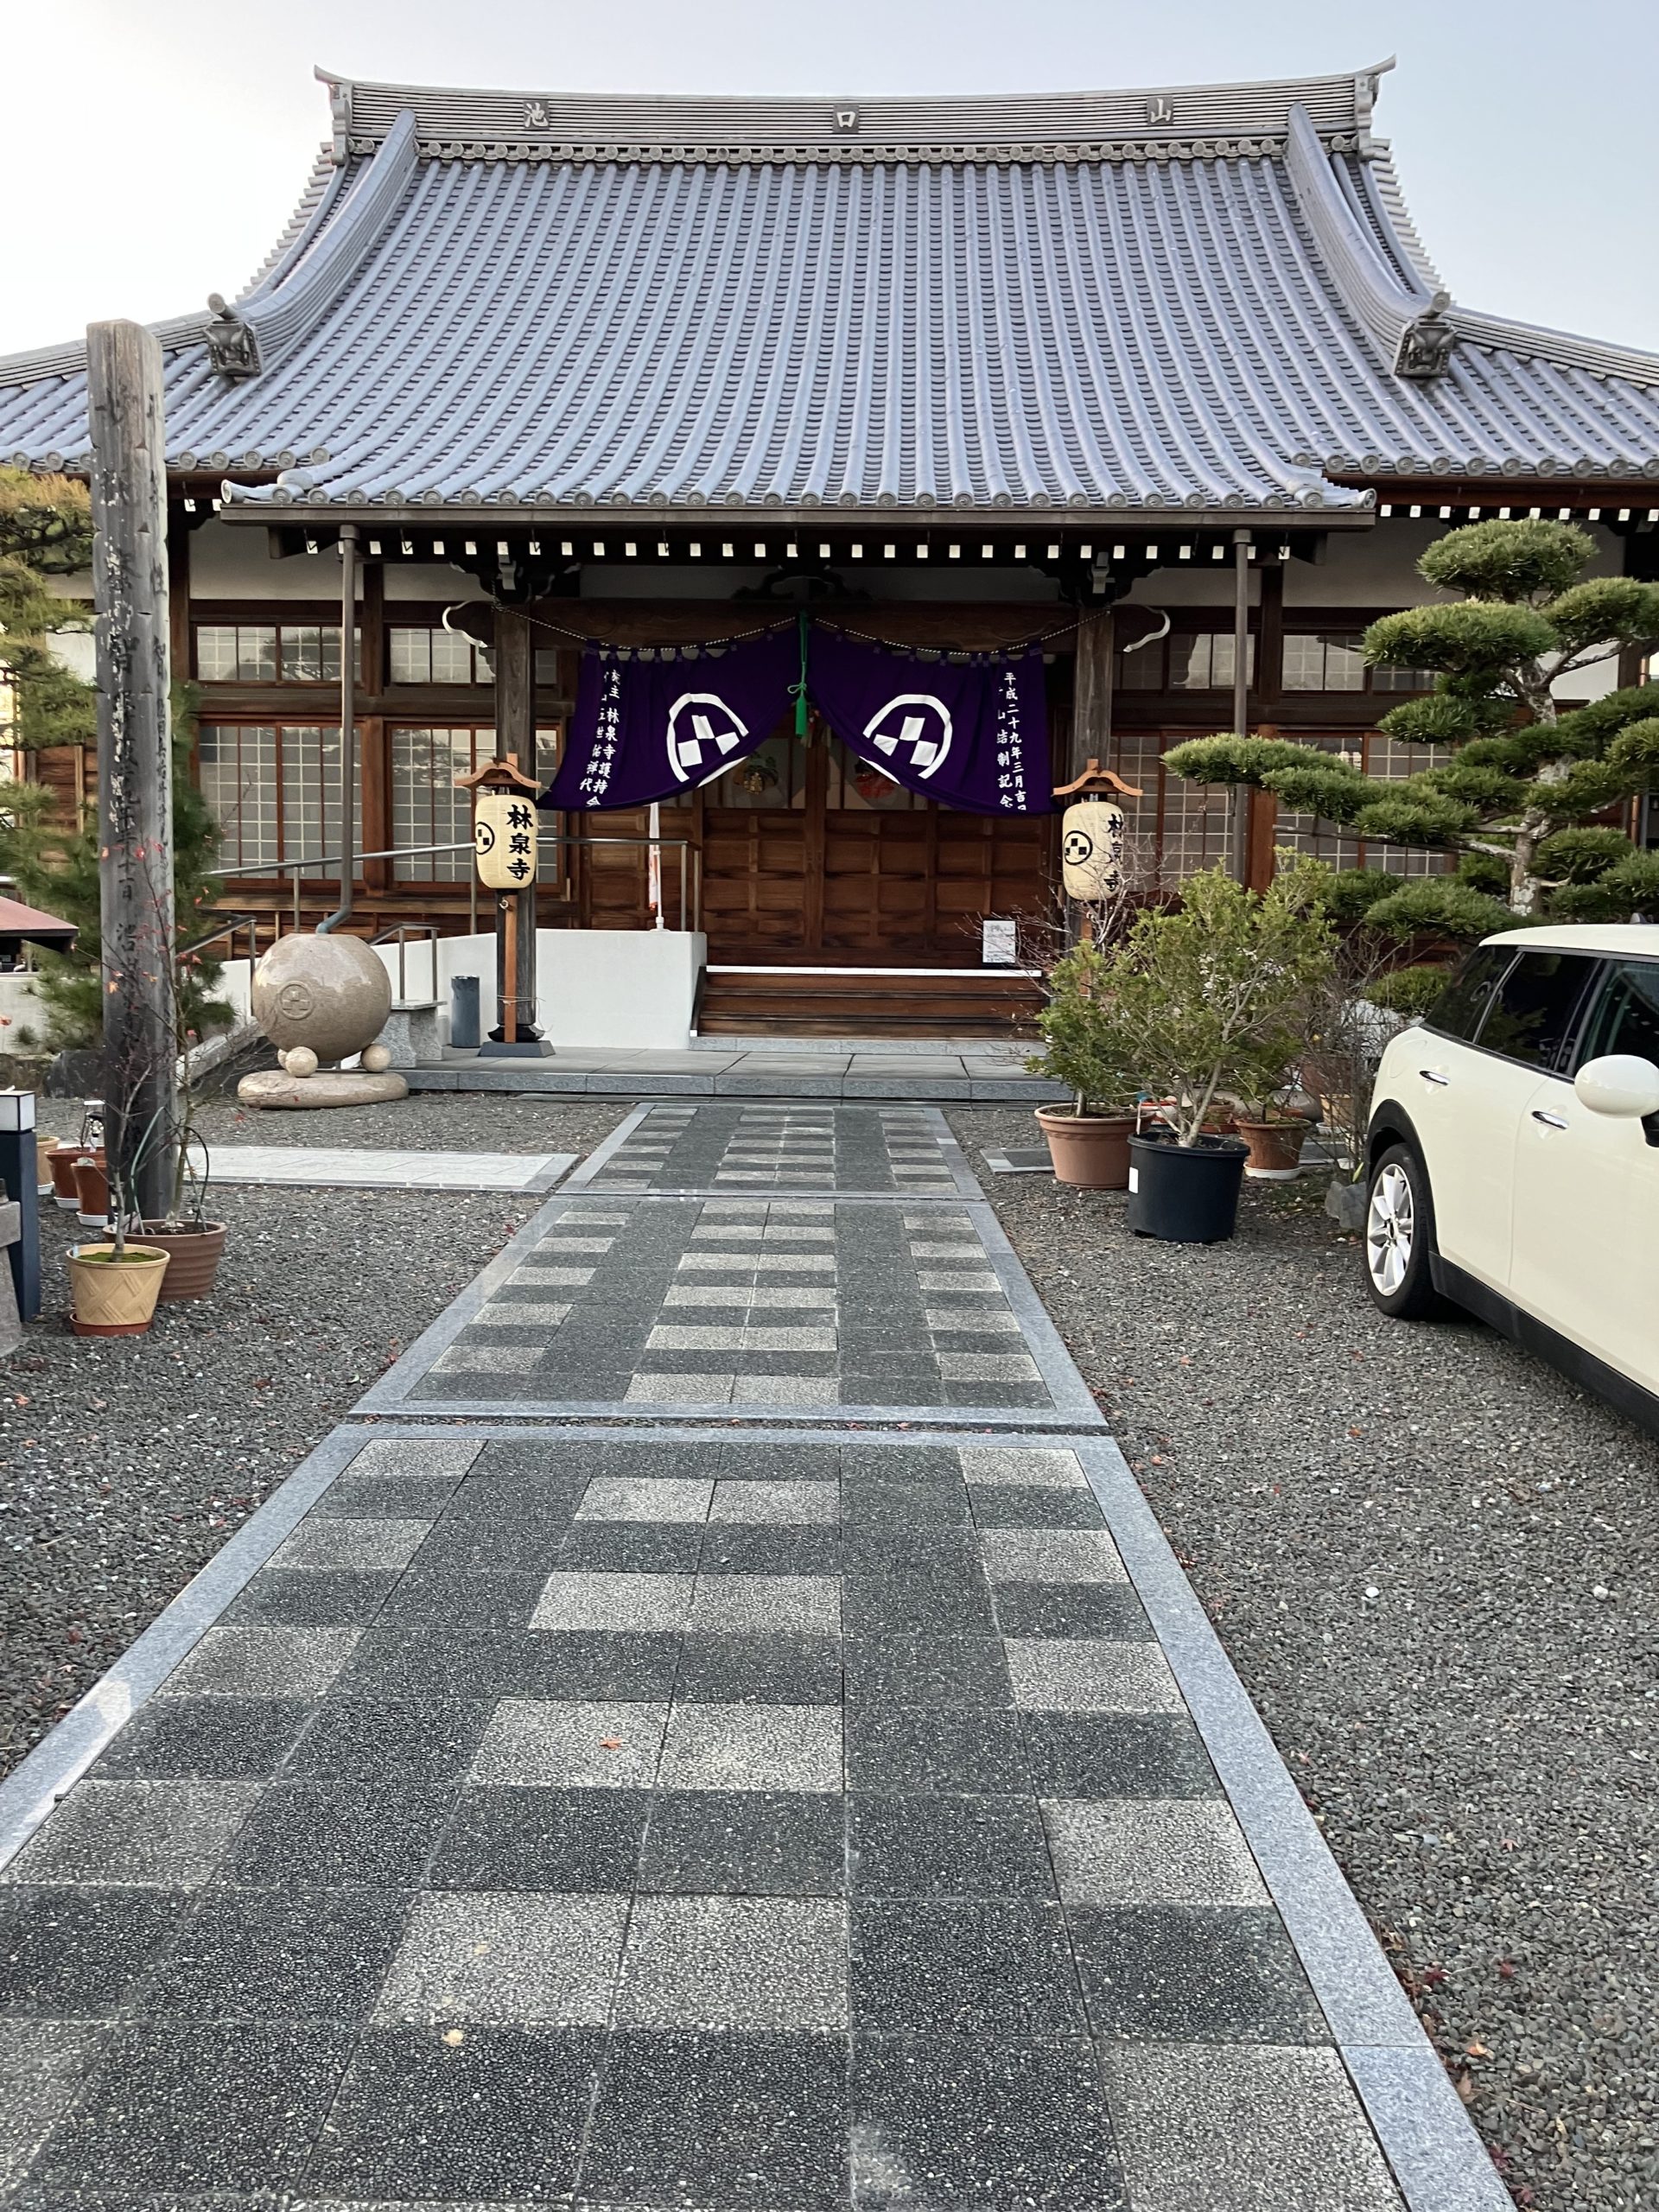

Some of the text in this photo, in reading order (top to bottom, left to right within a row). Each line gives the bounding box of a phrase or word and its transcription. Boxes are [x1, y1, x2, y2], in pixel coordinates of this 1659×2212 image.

[524, 98, 1172, 128] 池 口 山
[996, 686, 1014, 809] 山結制記念
[506, 804, 534, 880] 林泉寺
